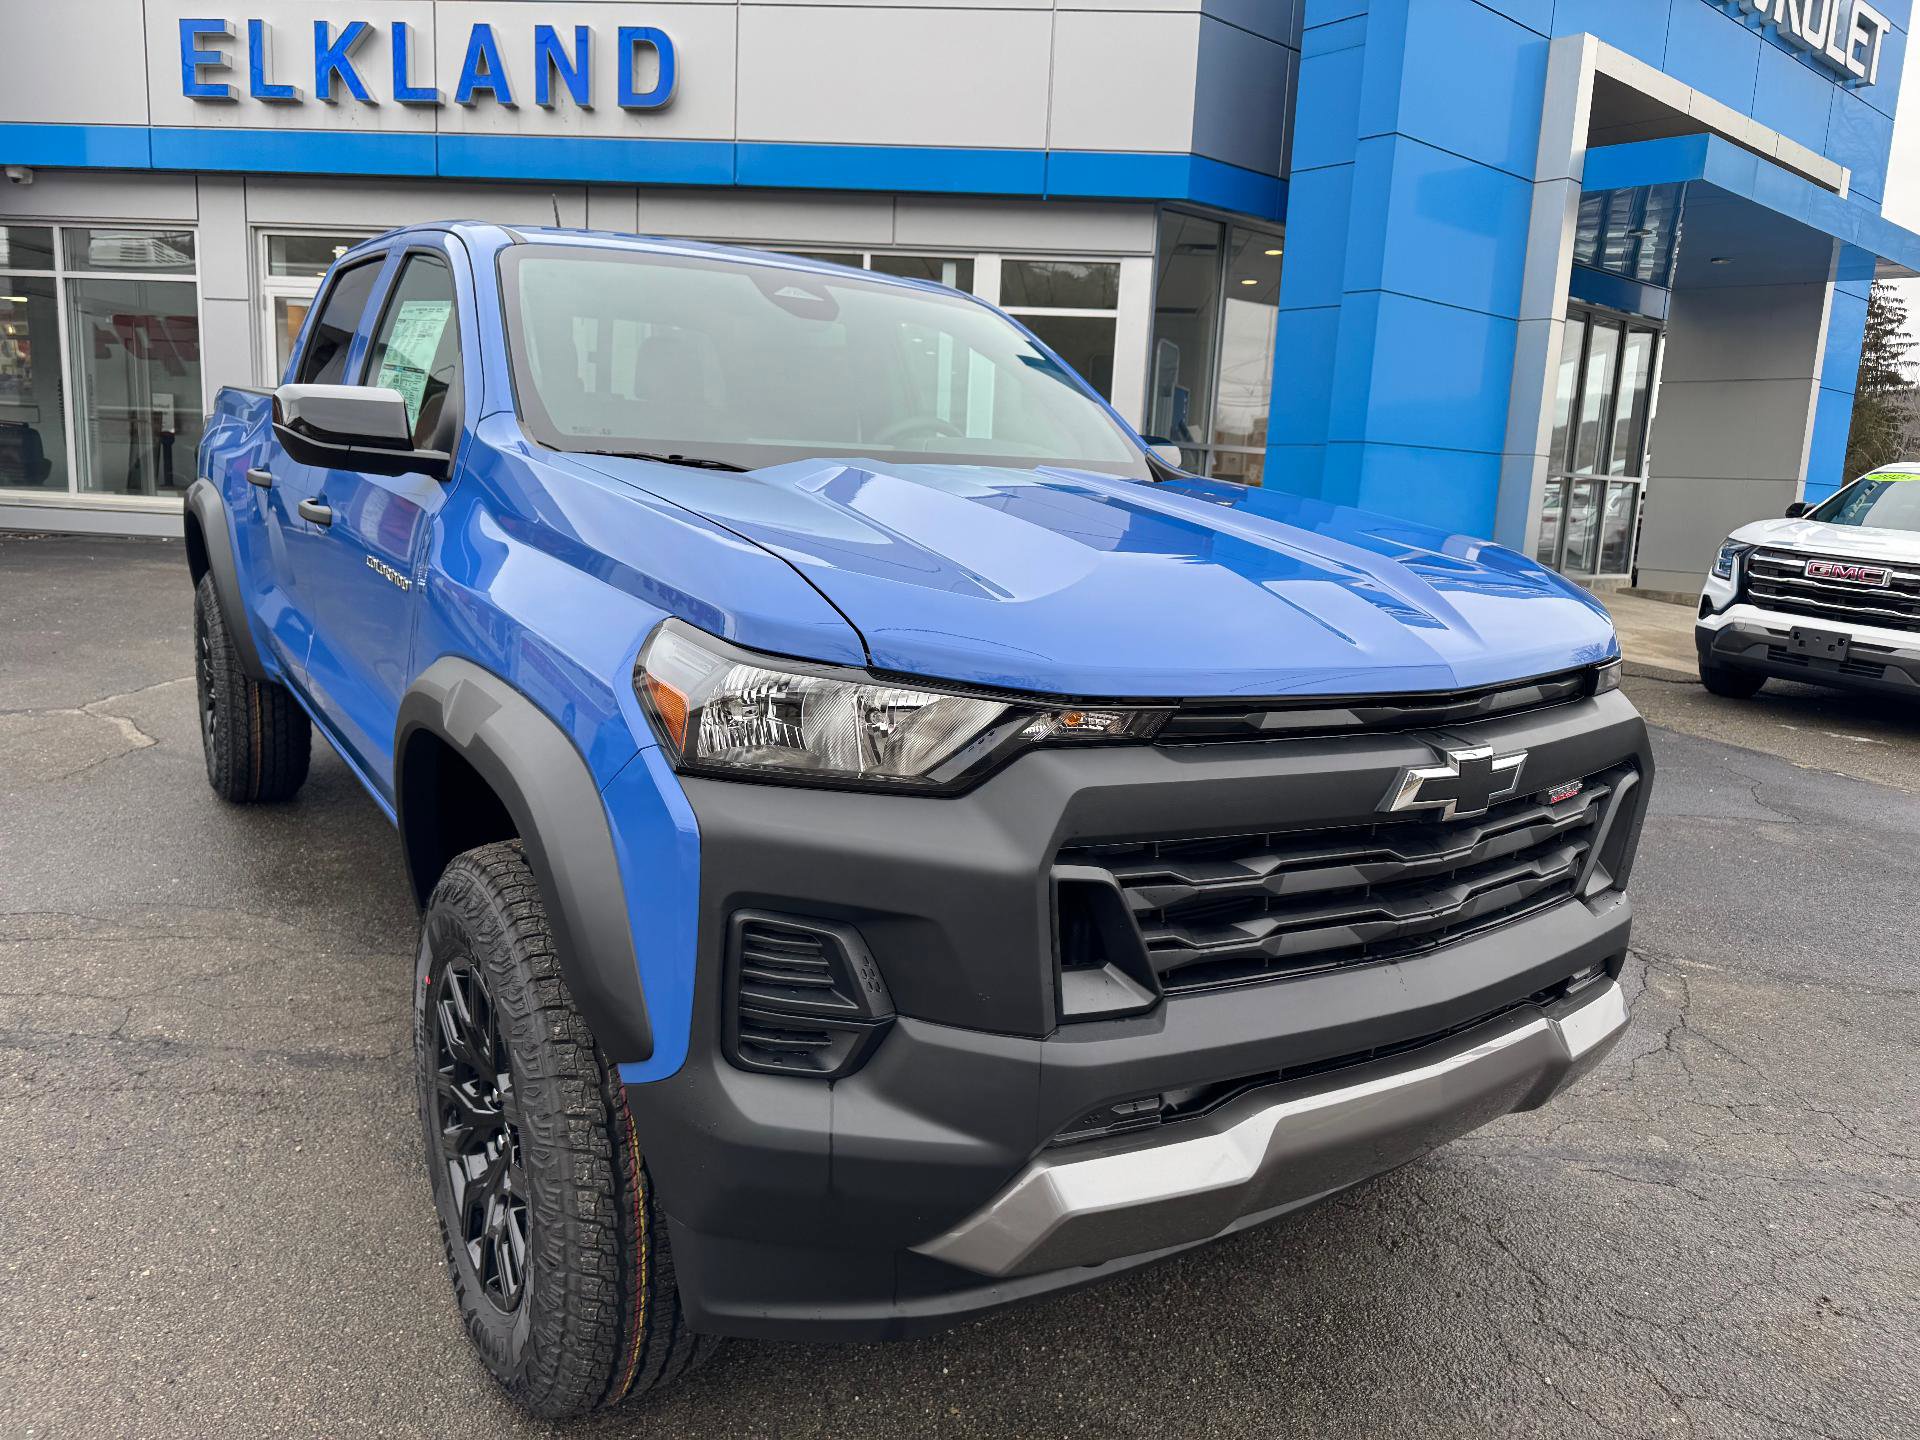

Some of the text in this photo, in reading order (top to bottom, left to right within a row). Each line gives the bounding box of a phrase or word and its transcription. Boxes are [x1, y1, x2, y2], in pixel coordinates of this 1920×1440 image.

[179, 18, 678, 111] ELKLAND
[1752, 0, 1892, 86] OLET
[1808, 562, 1886, 585] GMC
